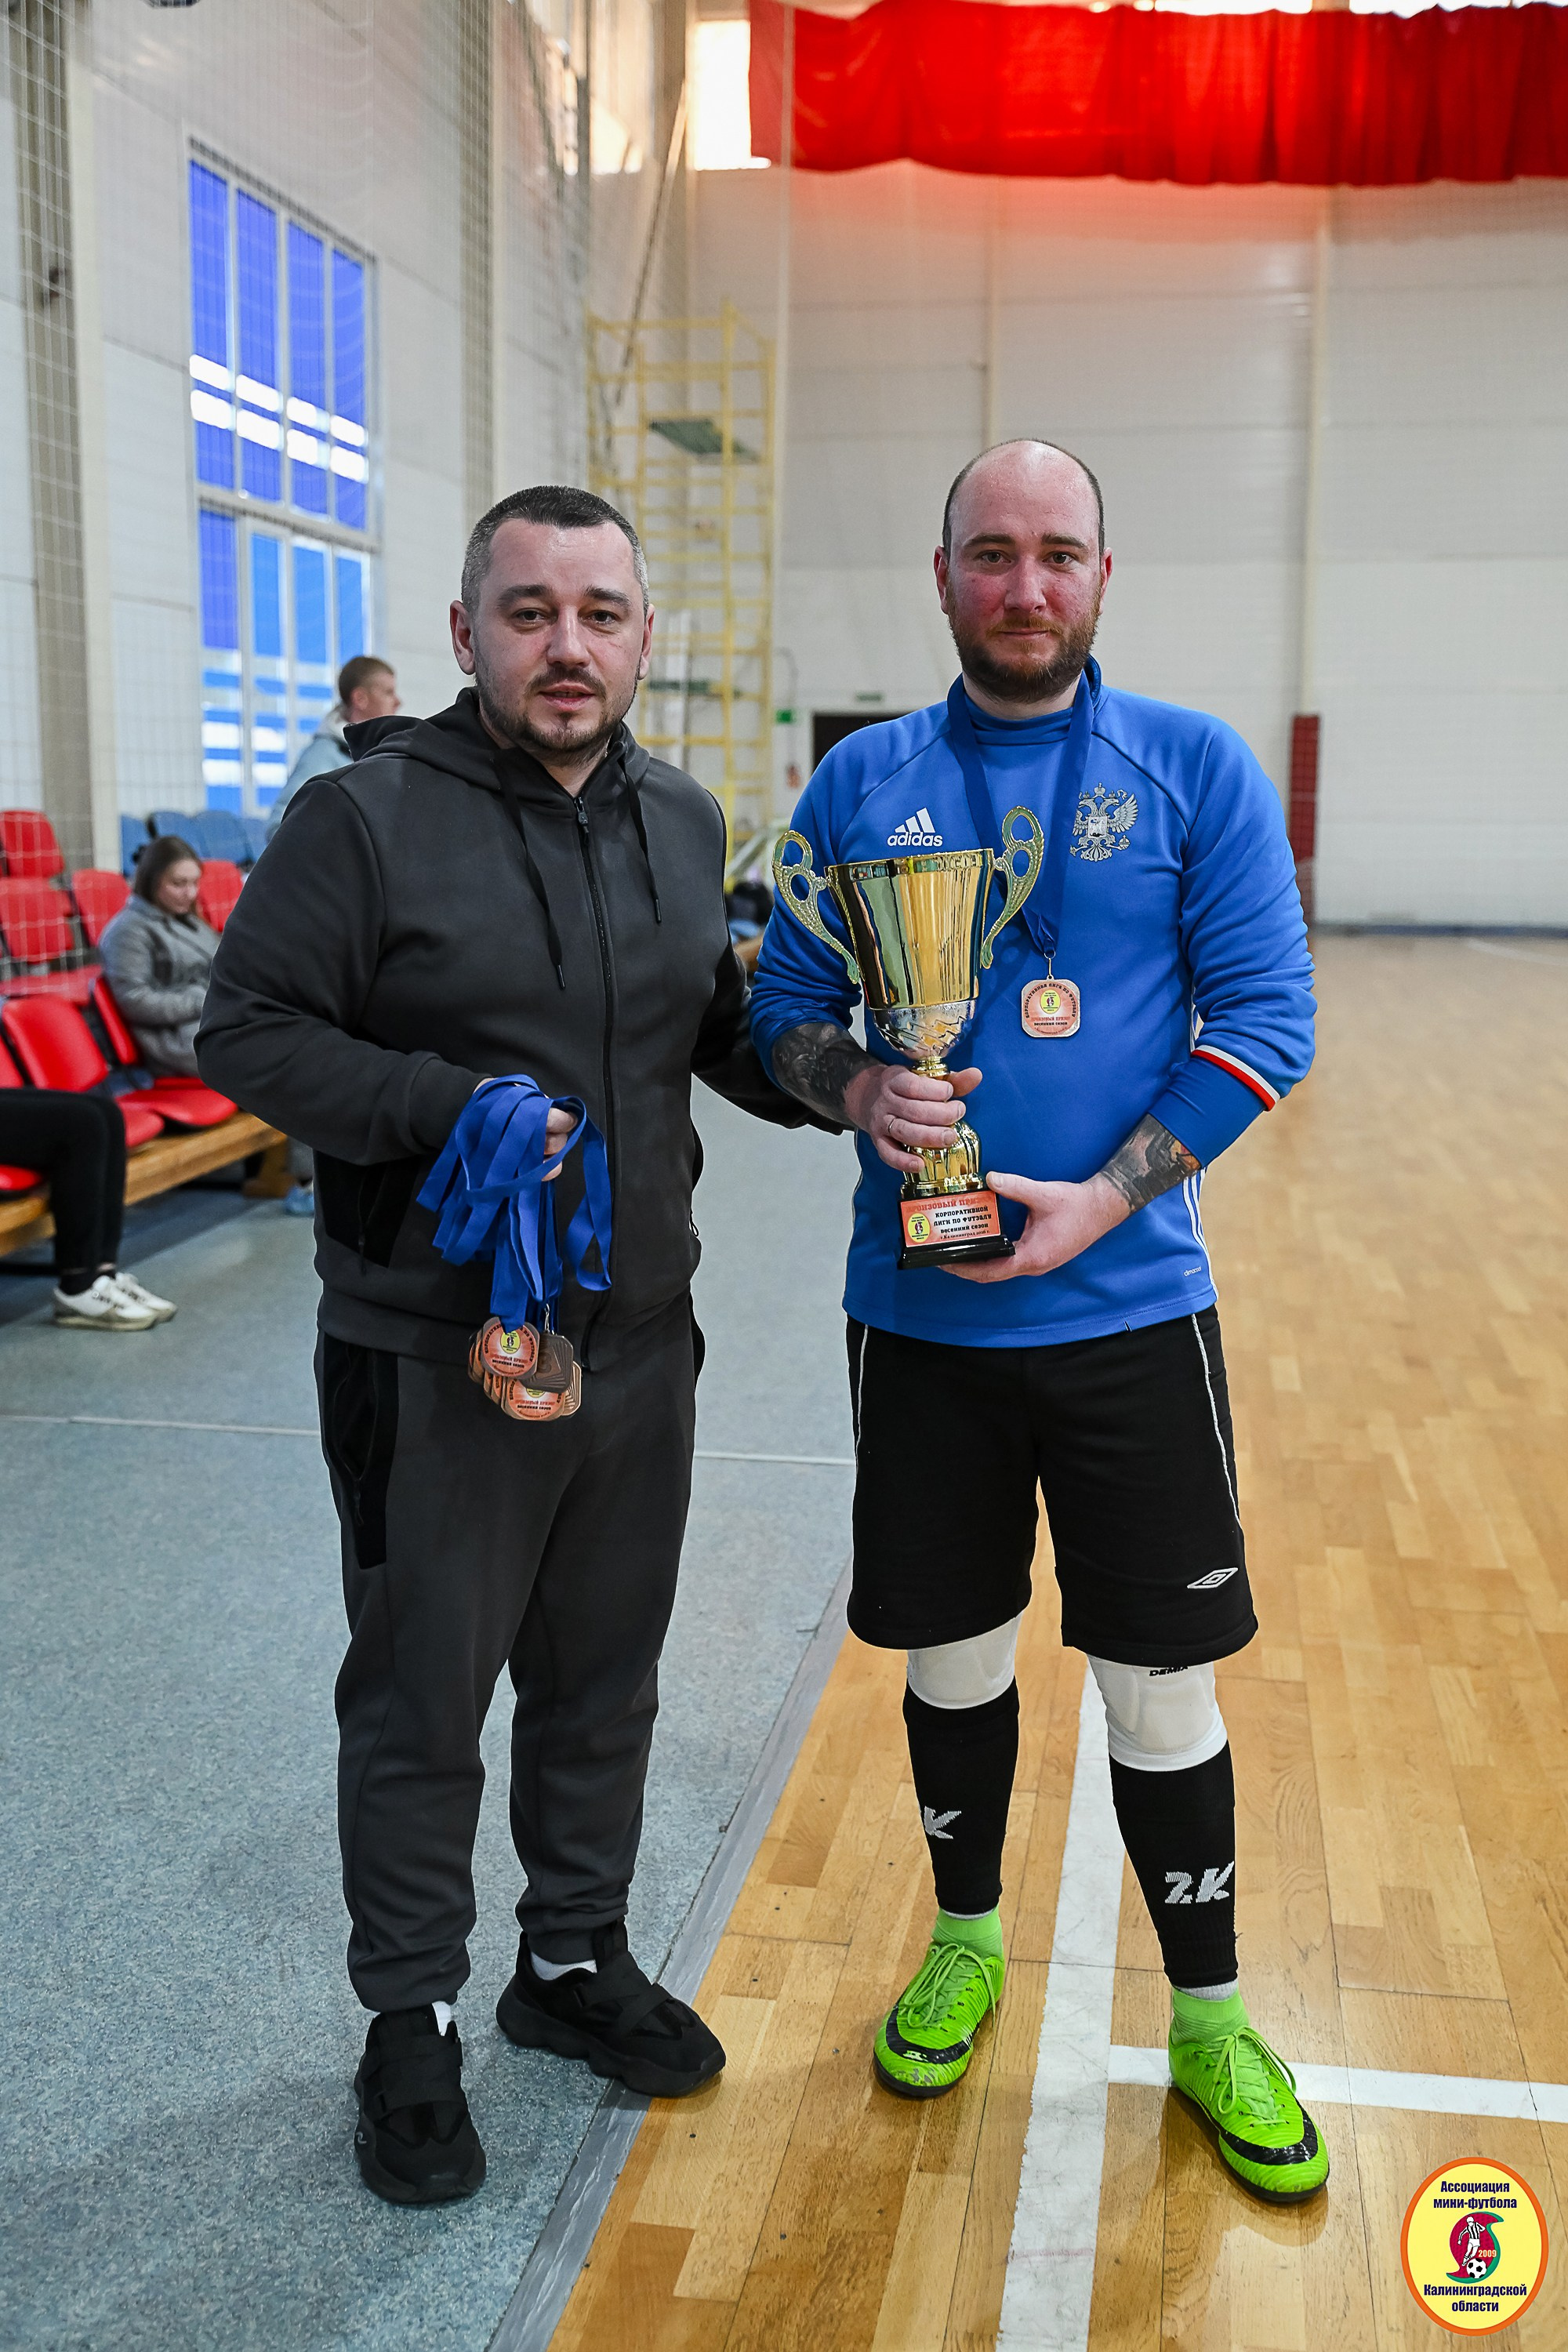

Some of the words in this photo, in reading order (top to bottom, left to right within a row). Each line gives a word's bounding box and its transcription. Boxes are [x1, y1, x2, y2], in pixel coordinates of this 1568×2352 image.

[887, 832, 943, 847] adidas
[935, 1205, 989, 1218] КОРПОРАТИВНОЙ
[933, 1218, 951, 1227] ЛИГИ
[962, 1214, 992, 1223] ФУТЗАЛУ
